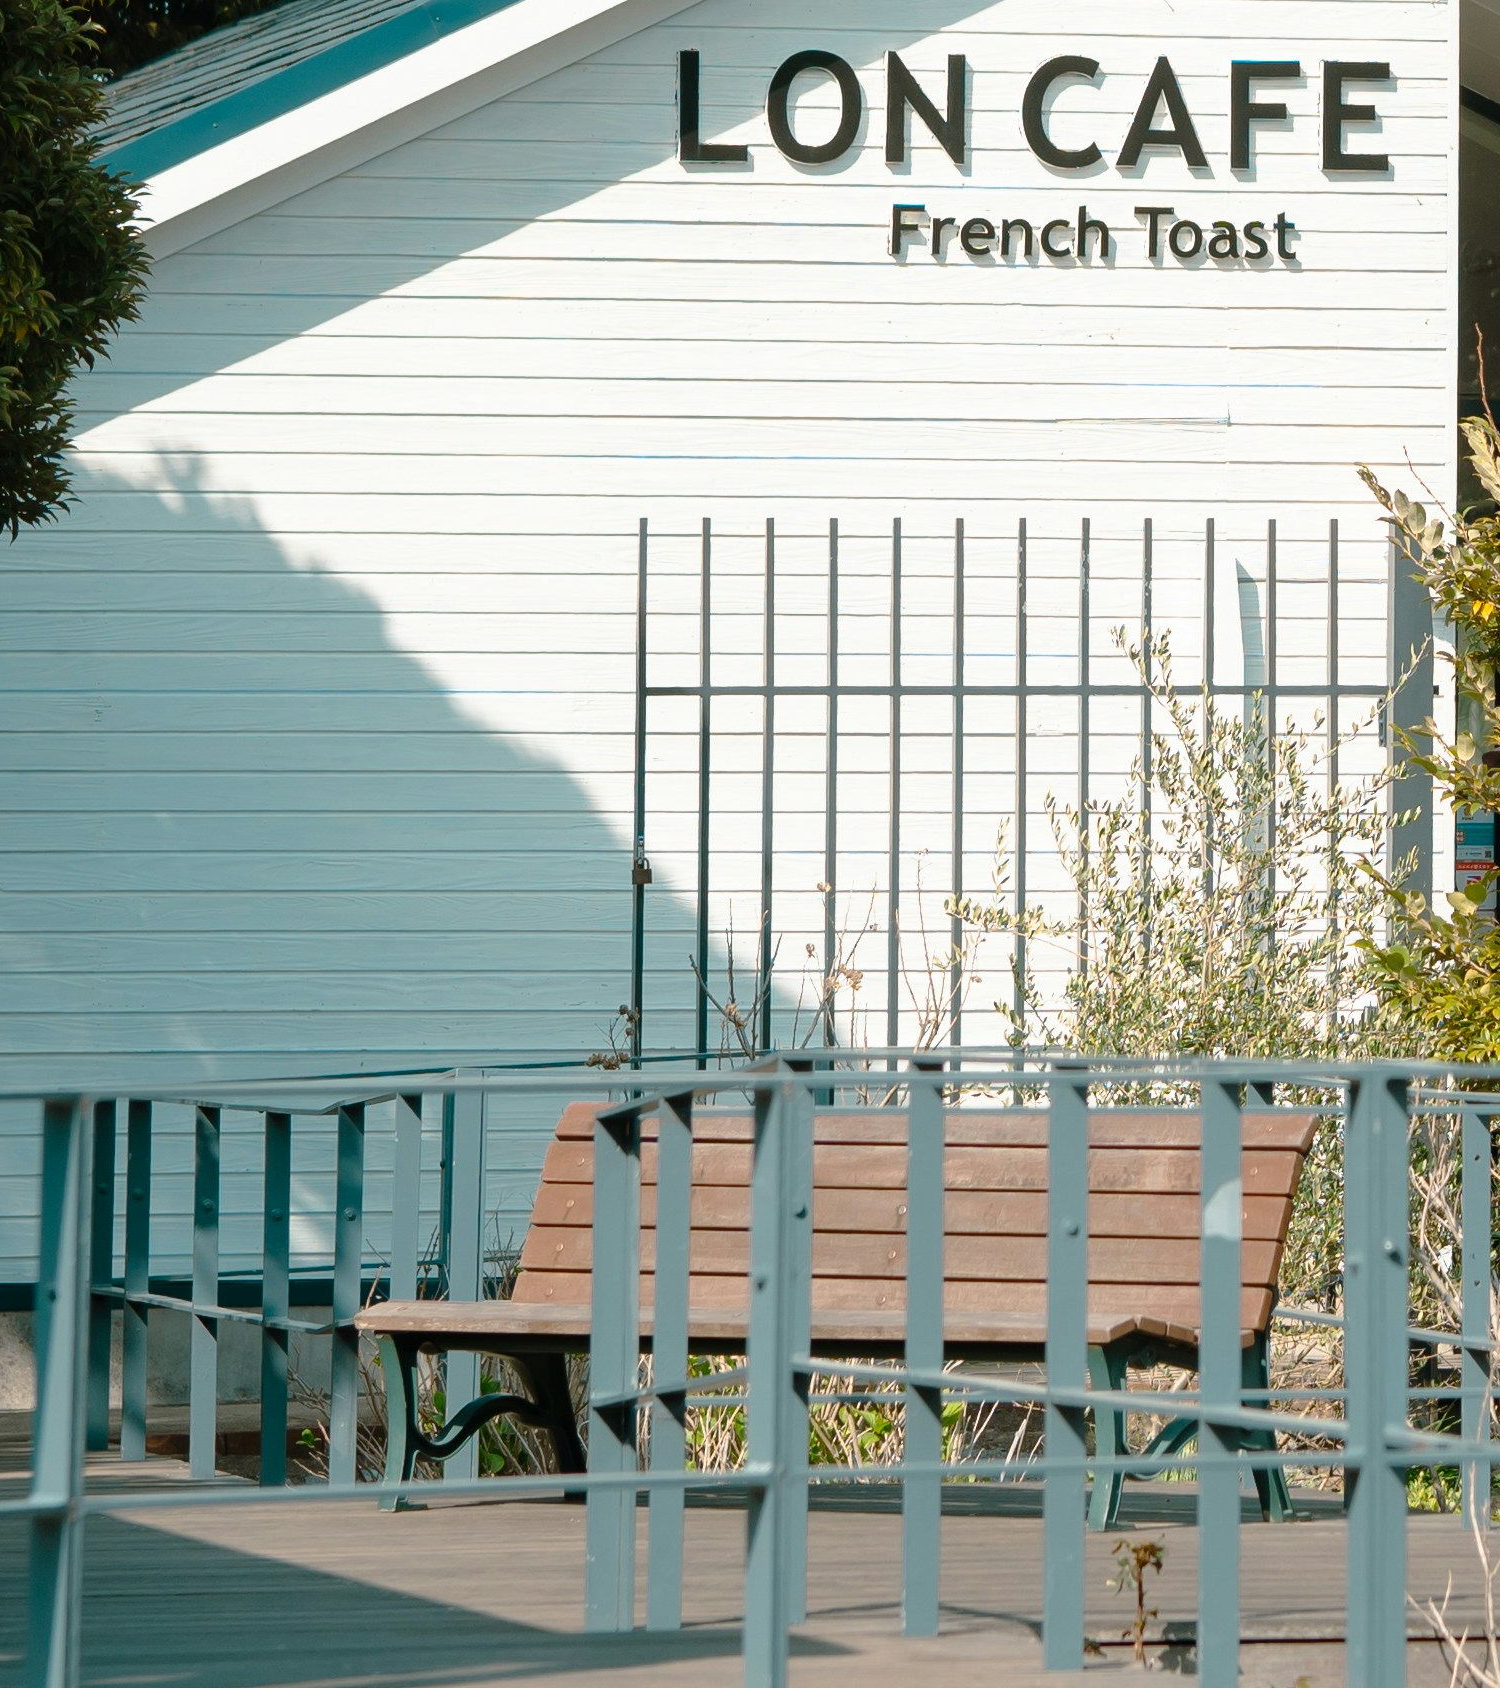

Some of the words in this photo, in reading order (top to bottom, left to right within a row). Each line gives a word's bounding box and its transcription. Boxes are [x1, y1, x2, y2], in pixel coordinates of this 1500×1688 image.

[678, 49, 967, 165] LON
[1021, 55, 1391, 171] CAFE
[889, 204, 1110, 258] French
[1133, 205, 1297, 261] Toast
